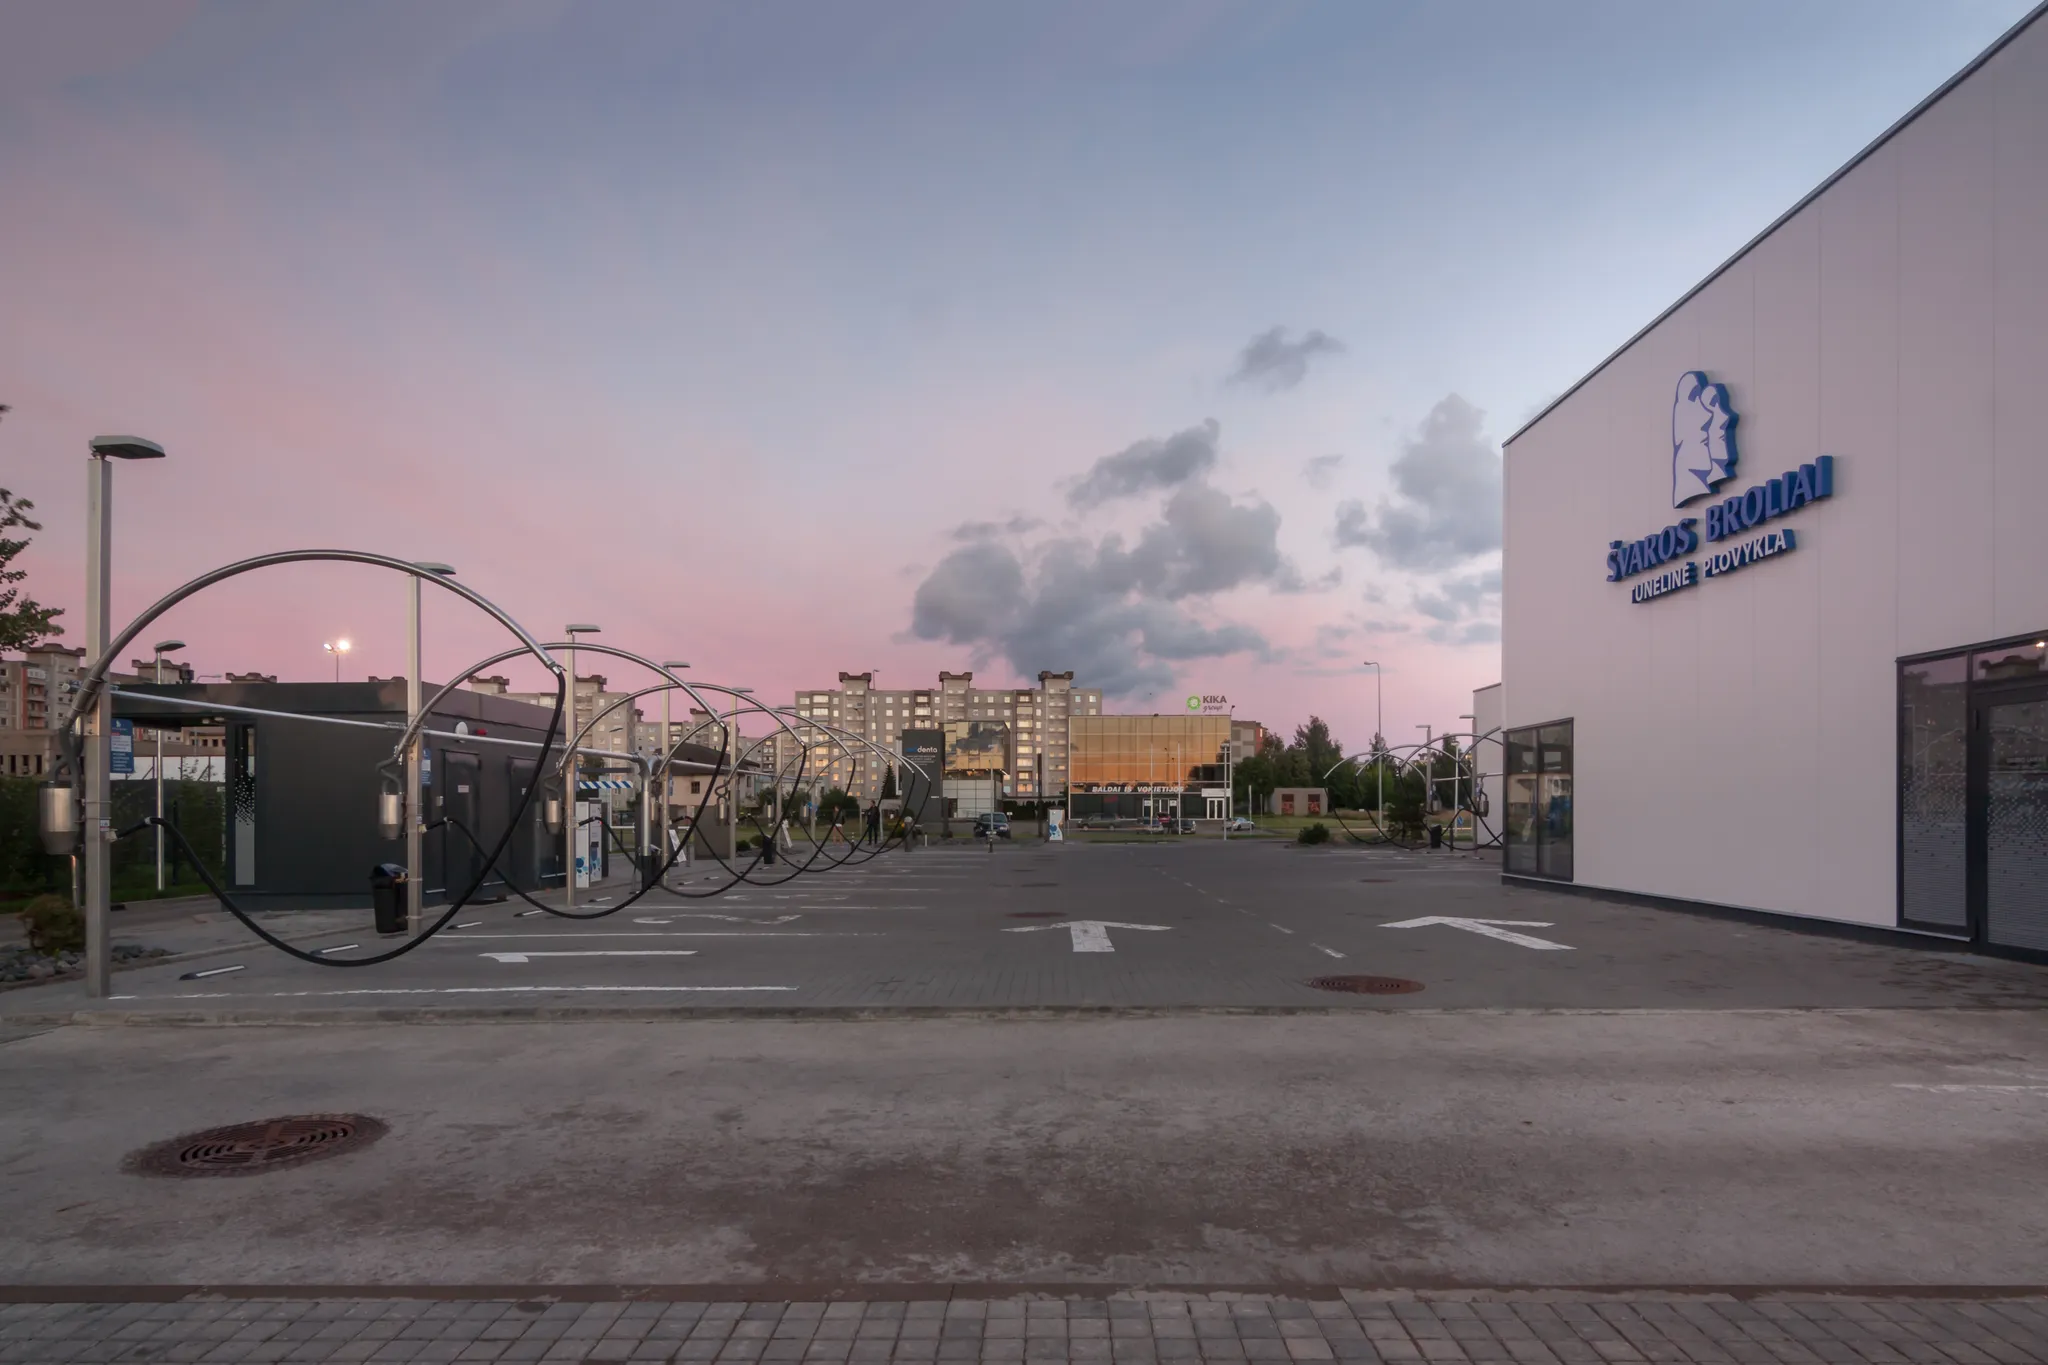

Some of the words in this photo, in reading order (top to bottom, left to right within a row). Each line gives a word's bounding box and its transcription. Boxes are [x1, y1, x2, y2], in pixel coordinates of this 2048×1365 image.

[1607, 518, 1698, 581] ŠVAROS
[1706, 455, 1833, 542] BROLIAI
[1704, 529, 1796, 577] PLOVYKLA
[1203, 696, 1227, 704] KIKA
